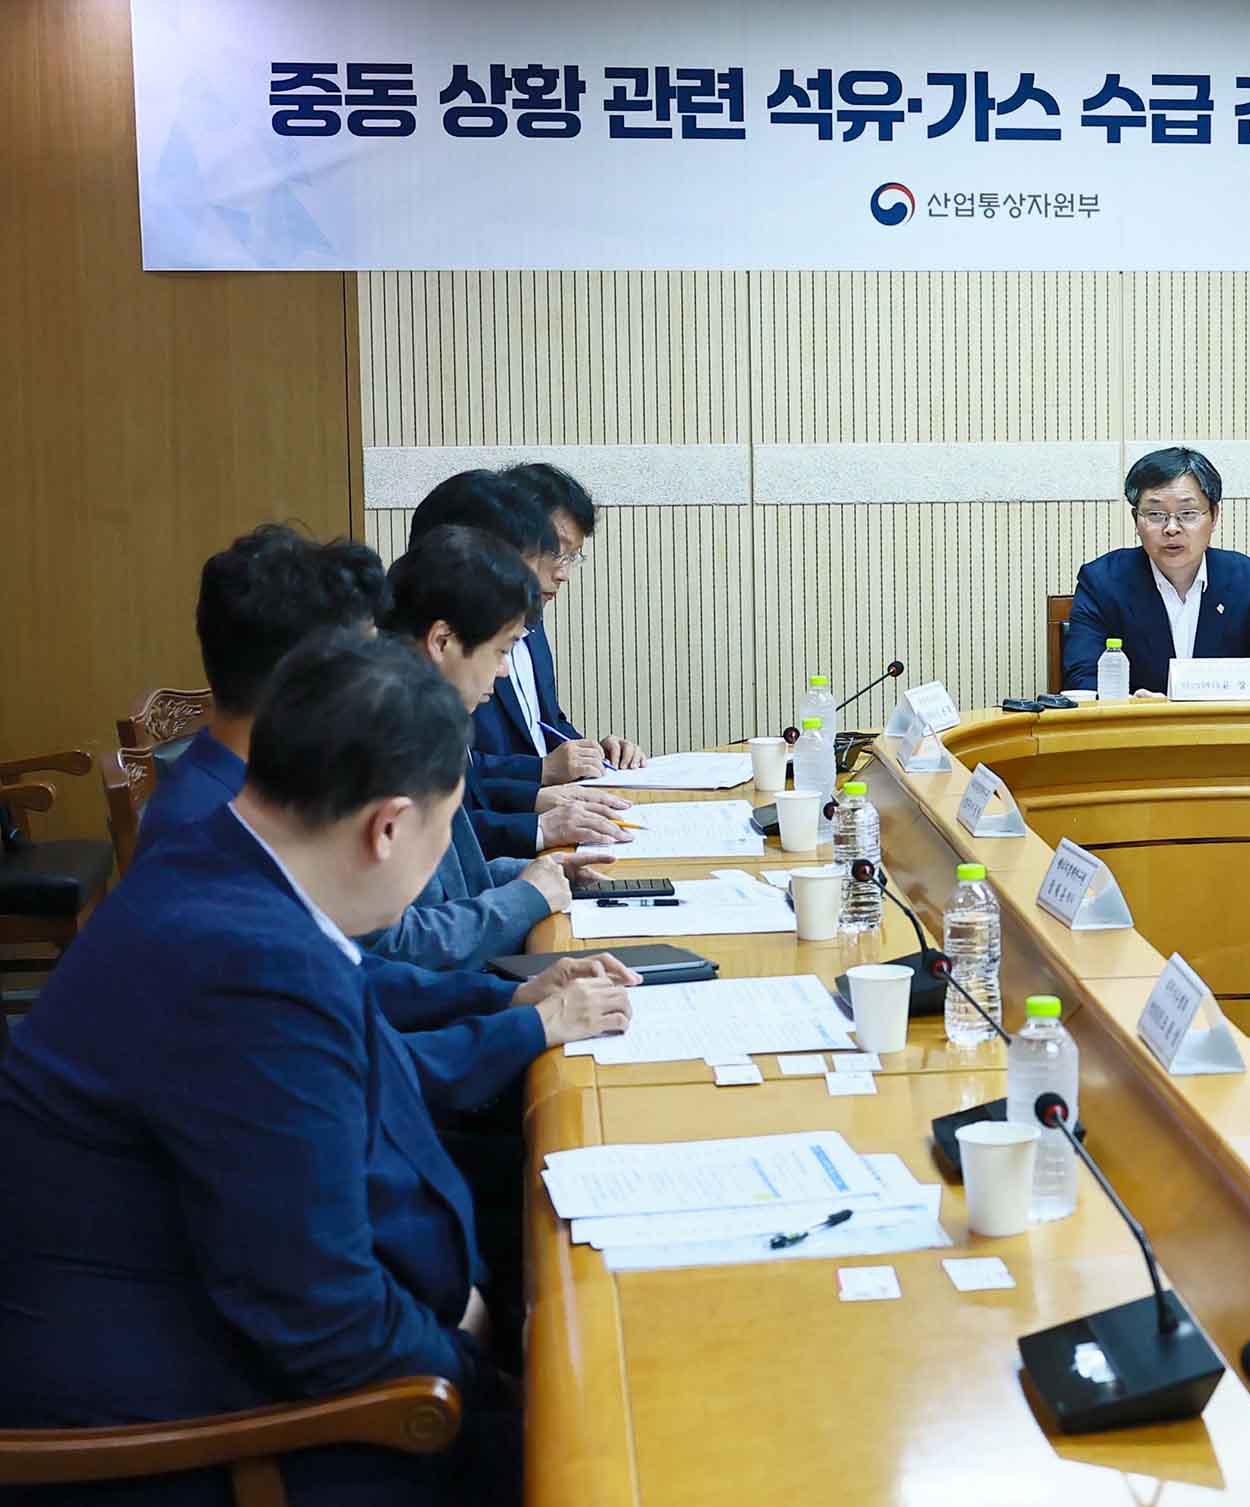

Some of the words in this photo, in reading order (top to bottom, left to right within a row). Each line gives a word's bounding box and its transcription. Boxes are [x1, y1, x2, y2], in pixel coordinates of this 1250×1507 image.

[269, 63, 417, 136] 중동
[440, 64, 586, 138] 상황
[604, 67, 745, 139] 관련
[767, 69, 1061, 142] 석유·가스
[1081, 74, 1214, 144] 수급
[928, 193, 1099, 218] 산업통상자원부
